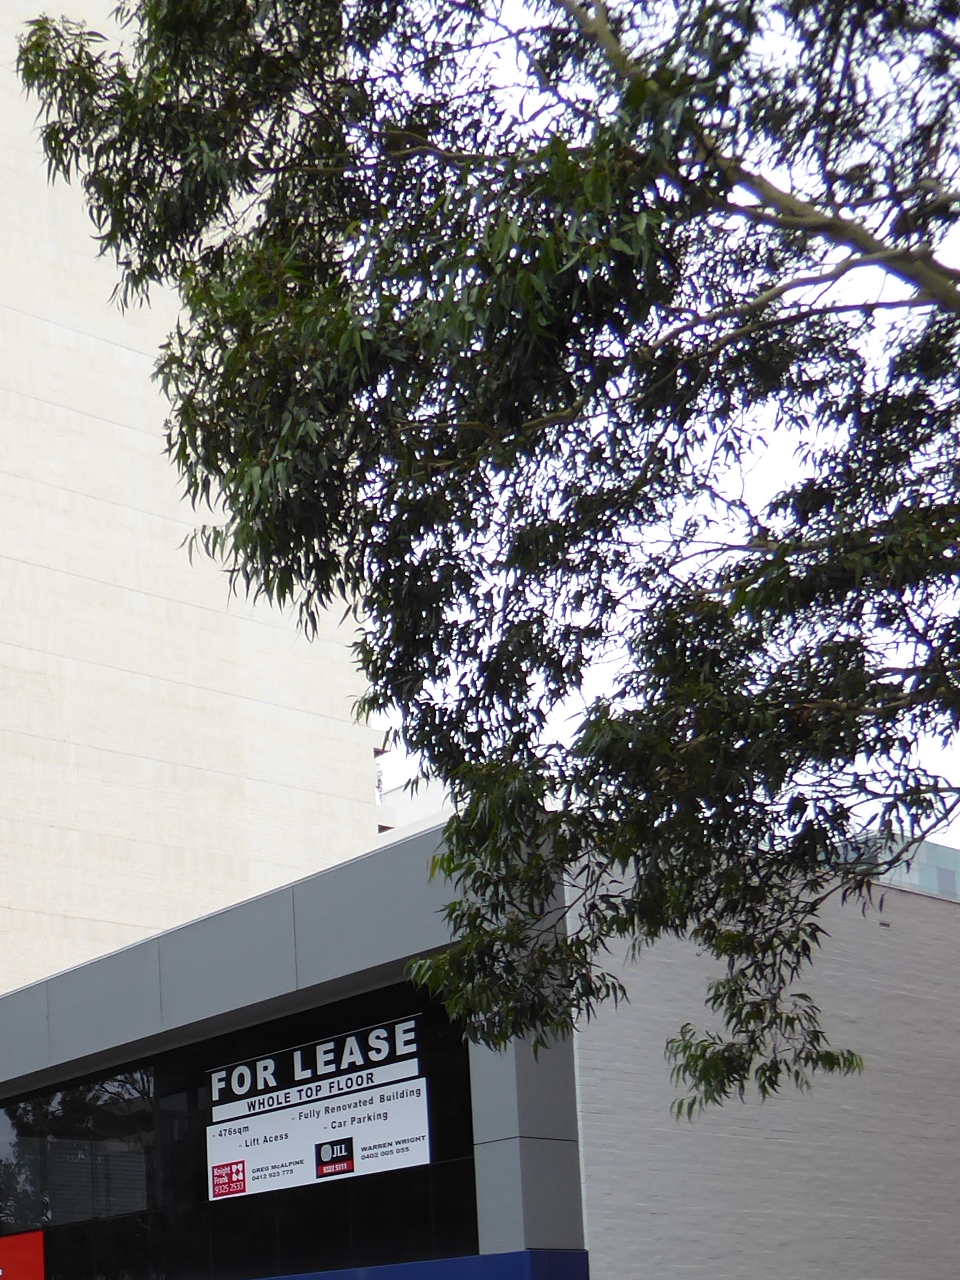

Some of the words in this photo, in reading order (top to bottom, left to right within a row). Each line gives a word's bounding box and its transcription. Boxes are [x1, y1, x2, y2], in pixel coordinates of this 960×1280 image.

[211, 1058, 277, 1101] FOR
[293, 1020, 417, 1081] LEASE
[247, 1092, 292, 1112] WHOLE
[297, 1084, 322, 1100] TOP
[329, 1072, 375, 1093] FLOOR
[298, 1108, 321, 1121] Fully
[324, 1096, 374, 1115] Renovated
[379, 1087, 422, 1104] Building
[330, 1119, 347, 1130] Car
[350, 1111, 388, 1126] Parking
[218, 1124, 250, 1138] 476sqm
[244, 1138, 260, 1148] Lift
[262, 1132, 289, 1144] Acess
[361, 1141, 393, 1152] WARREN
[394, 1135, 426, 1146] WRIGHT
[332, 1144, 348, 1157] JLL
[213, 1165, 231, 1177] Knight
[251, 1165, 270, 1174] GREG
[271, 1159, 305, 1172] McALPINE
[214, 1174, 229, 1185] Frank
